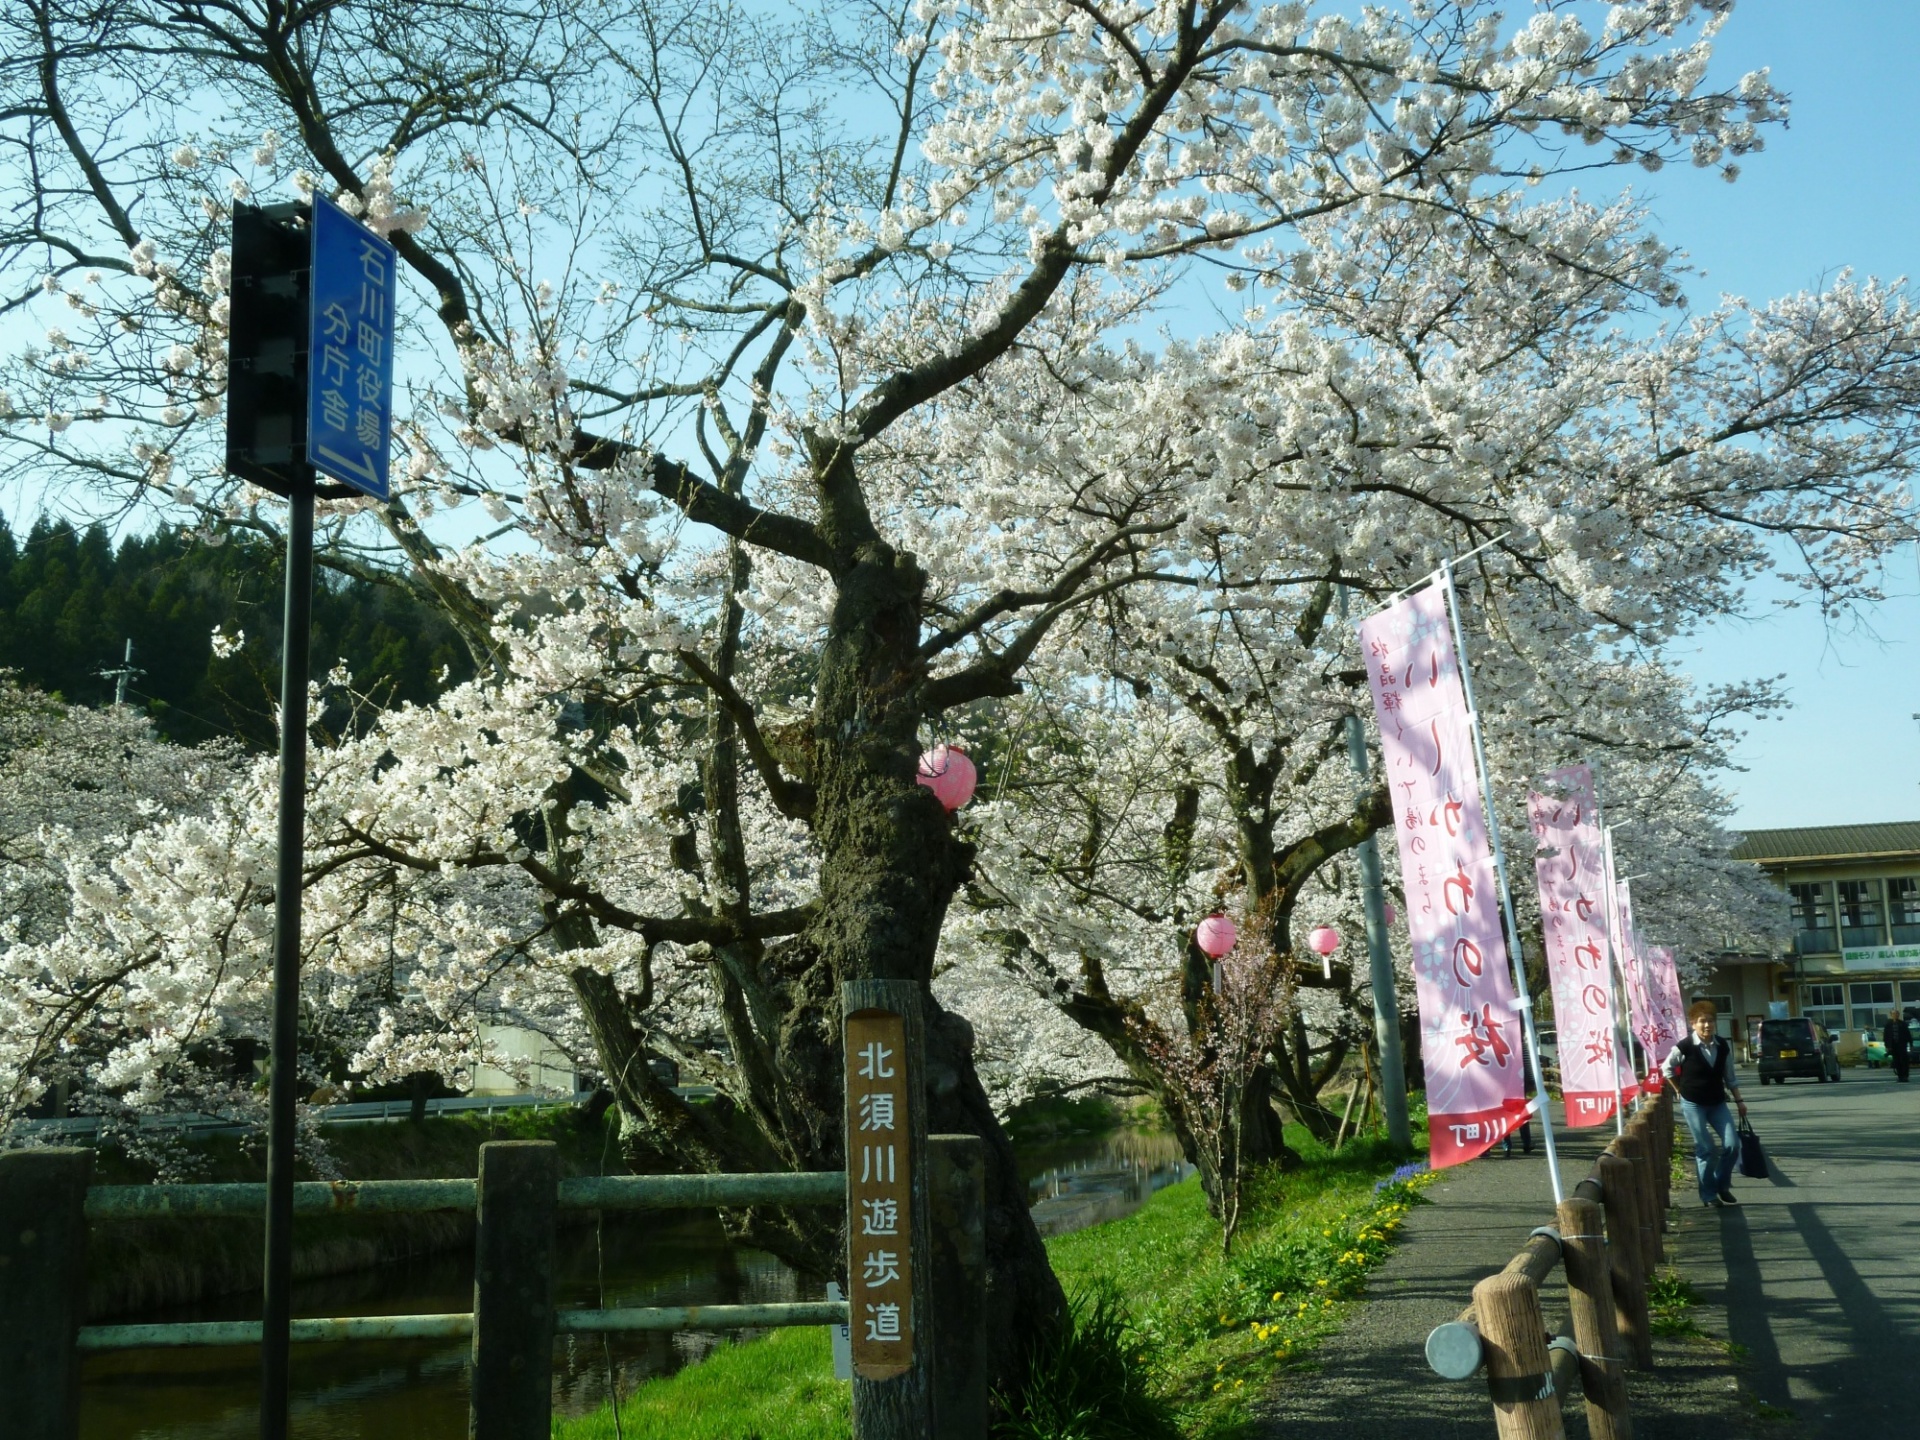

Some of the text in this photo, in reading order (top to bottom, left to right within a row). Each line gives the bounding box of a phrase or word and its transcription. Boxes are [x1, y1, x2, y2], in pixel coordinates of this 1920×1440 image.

[320, 302, 352, 432] 分庁舎
[354, 238, 387, 452] 石川町役場
[857, 1041, 902, 1343] 北須川遊歩道
